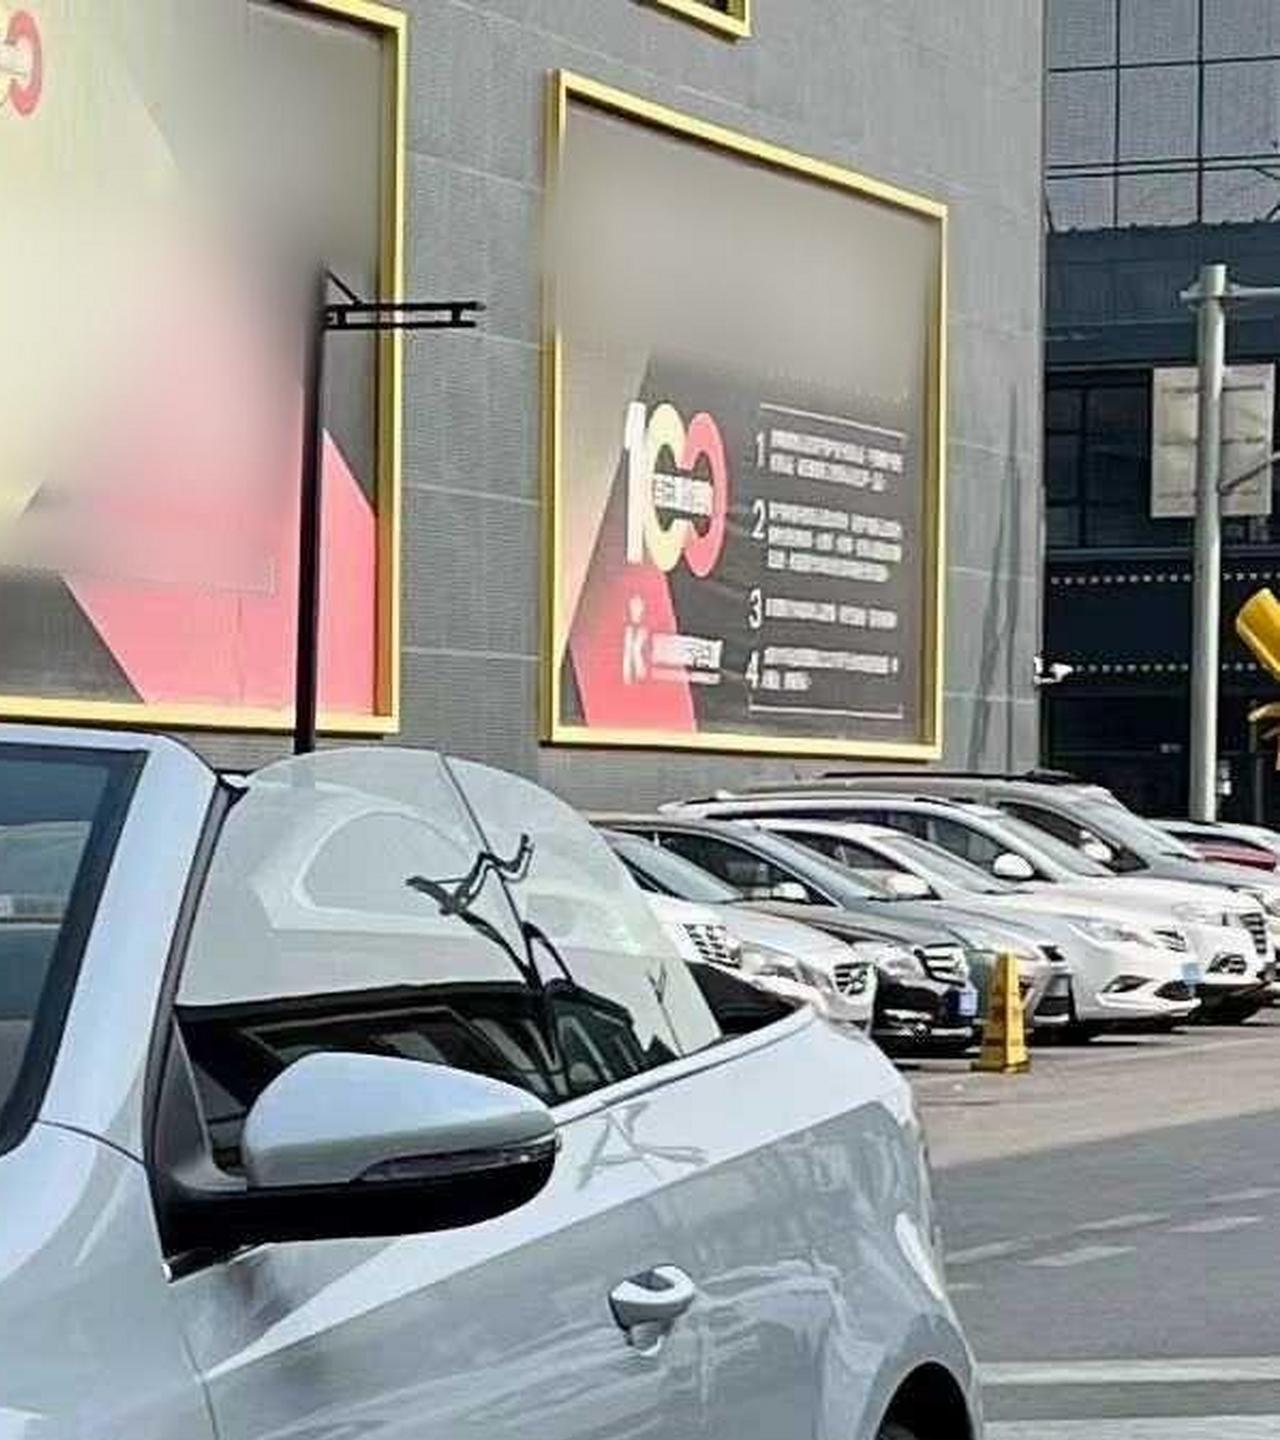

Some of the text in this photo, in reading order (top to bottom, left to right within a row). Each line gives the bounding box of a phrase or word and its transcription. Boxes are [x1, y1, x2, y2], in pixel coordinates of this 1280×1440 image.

[755, 430, 767, 468] 1
[751, 498, 766, 540] 2
[748, 588, 763, 629] 3
[745, 650, 760, 690] 4
